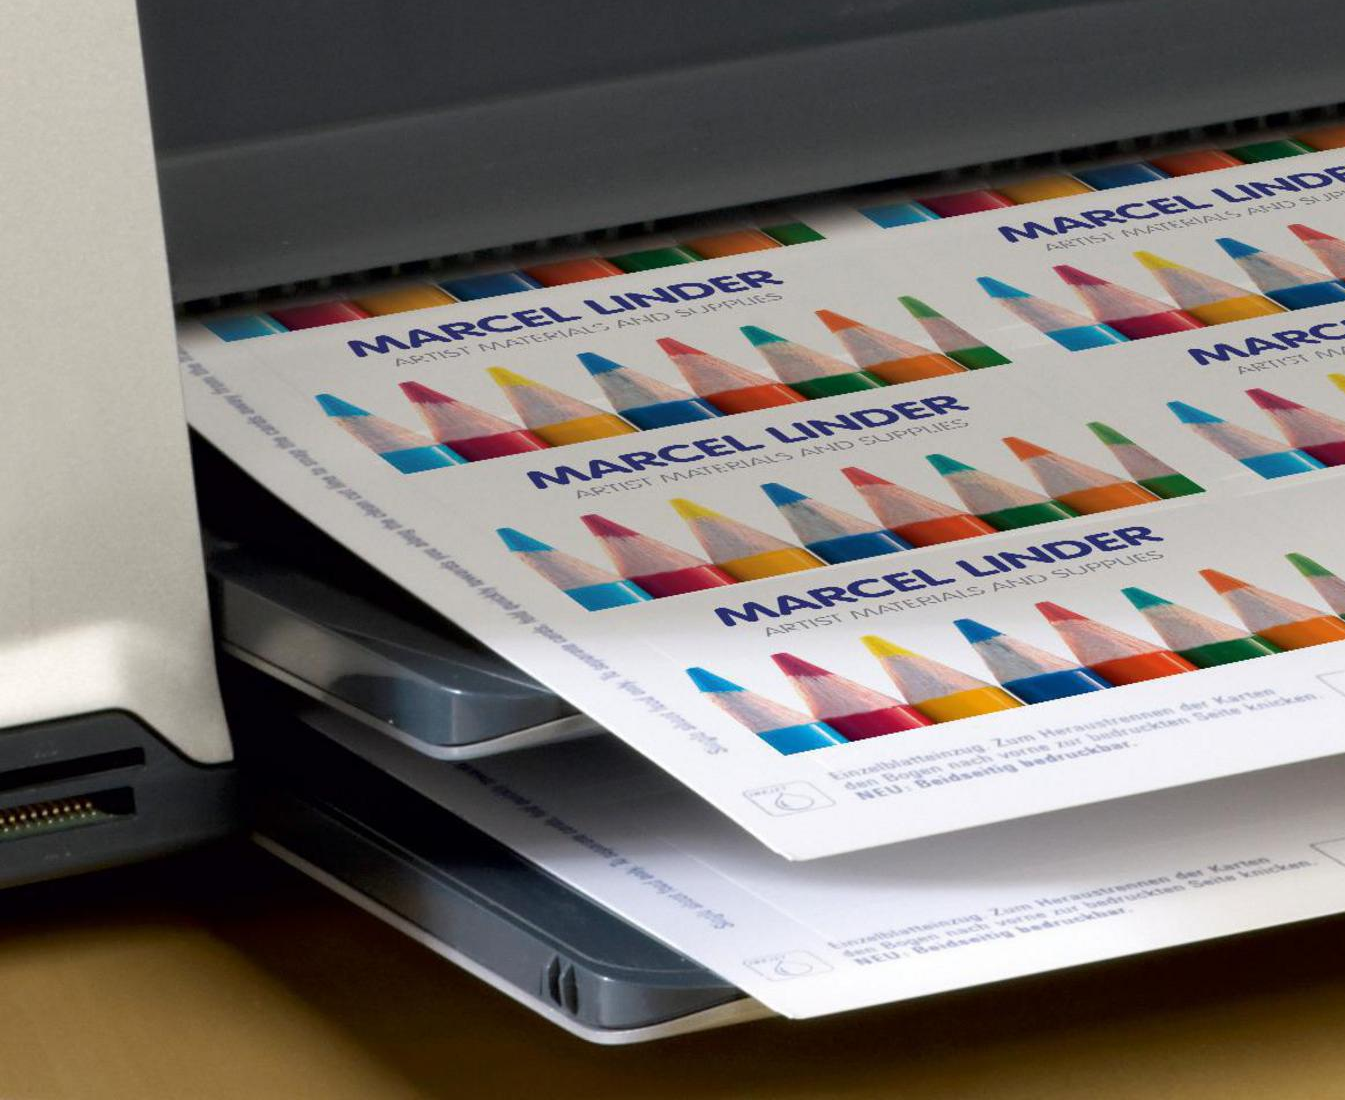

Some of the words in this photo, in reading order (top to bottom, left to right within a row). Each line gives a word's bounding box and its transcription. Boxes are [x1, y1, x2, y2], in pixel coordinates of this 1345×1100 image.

[998, 196, 1214, 243] MARCEL
[1046, 233, 1115, 251] ARTIST
[1121, 211, 1242, 237] MATERIALS
[1248, 201, 1296, 215] AND
[347, 307, 582, 357] MARCEL
[583, 270, 784, 315] LINDER
[396, 346, 470, 367] ARTIST
[478, 323, 610, 352] MATERIALS
[617, 313, 670, 328] AND
[674, 293, 783, 317] SUPPLIES
[1238, 354, 1309, 375] ARTIST
[527, 435, 766, 489] MARCEL
[765, 396, 969, 443] LINDER
[577, 477, 652, 499] ARTIST
[659, 453, 793, 483] MATERIALS
[801, 441, 854, 457] AND
[858, 419, 968, 445] SUPPLIES
[714, 569, 956, 627] MARCEL
[956, 527, 1164, 577] LINDER
[766, 613, 842, 637] ARTIST
[850, 587, 985, 619] MATERIALS
[992, 575, 1047, 592] AND
[1051, 551, 1164, 578] SUPPLIES
[844, 779, 880, 790] den
[881, 766, 953, 782] Bogen
[947, 756, 996, 769] nach
[997, 745, 1051, 761] vorne
[1055, 738, 1088, 749] zur
[1086, 718, 1190, 746] bedruckten
[1192, 708, 1242, 721] Seite
[990, 735, 1036, 748] Zum
[1037, 708, 1175, 738] Heraustrennen
[1179, 701, 1208, 713] der
[1212, 689, 1276, 705] Karten
[914, 764, 1018, 788] Beidseitig
